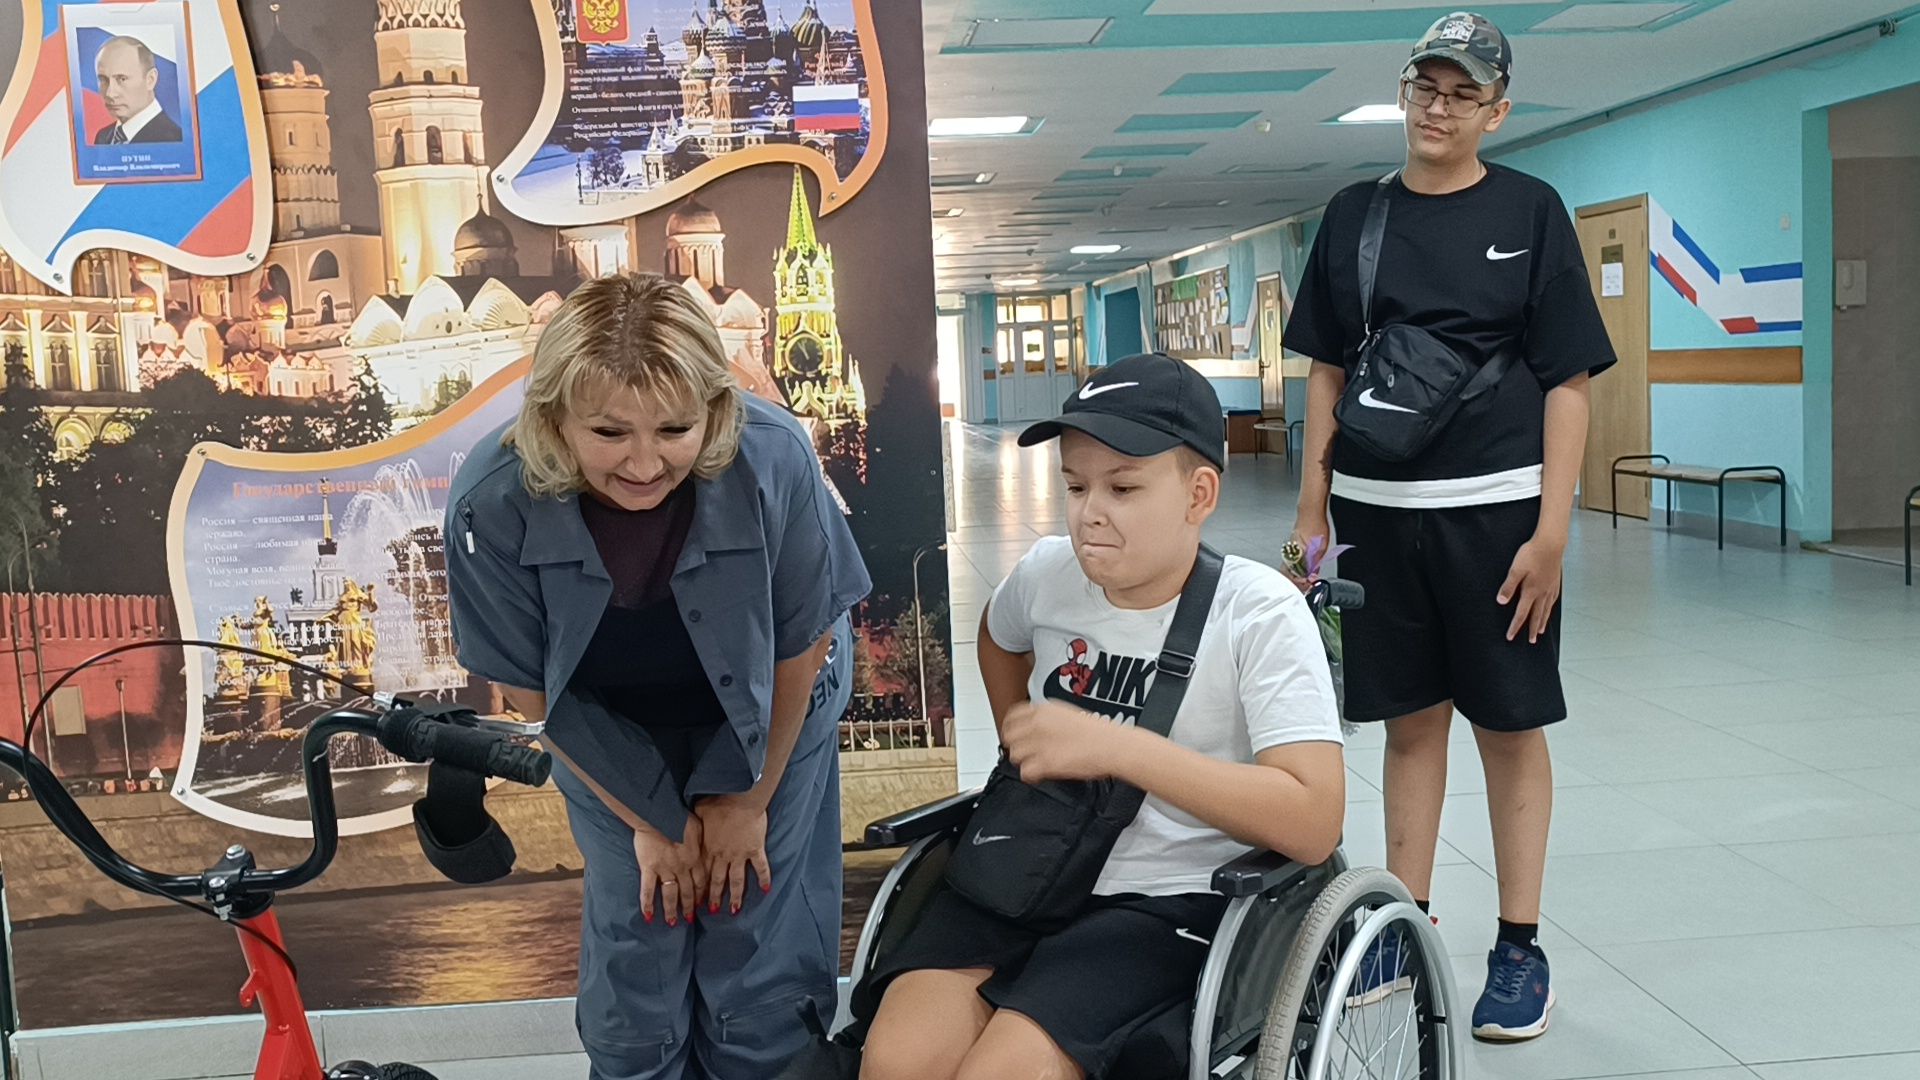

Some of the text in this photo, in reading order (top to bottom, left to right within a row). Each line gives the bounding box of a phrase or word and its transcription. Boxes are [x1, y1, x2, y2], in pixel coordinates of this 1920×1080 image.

[201, 516, 237, 527] Россия
[252, 513, 306, 525] священная
[203, 542, 238, 552] Россия
[255, 537, 299, 549] любимая
[1087, 650, 1158, 708] NIK
